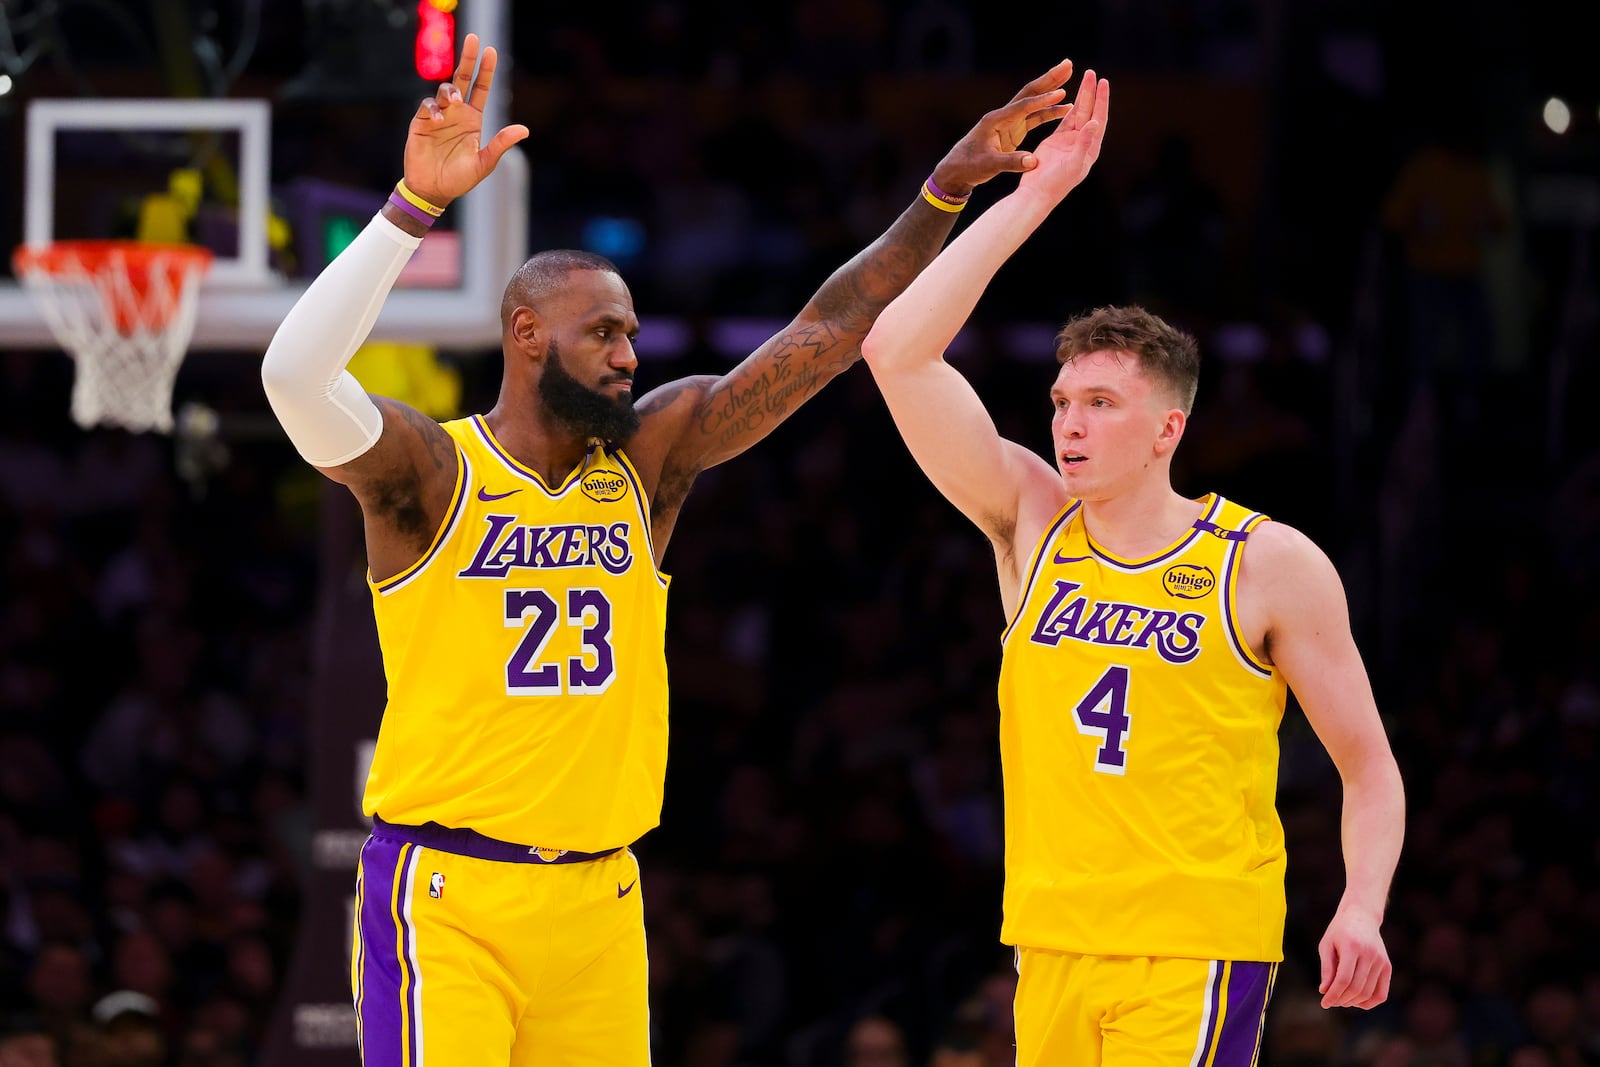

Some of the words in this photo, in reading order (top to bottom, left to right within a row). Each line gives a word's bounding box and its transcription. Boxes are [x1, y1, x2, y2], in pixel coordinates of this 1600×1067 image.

[584, 478, 624, 492] bibigo
[456, 513, 634, 579] LAKERS
[1168, 571, 1212, 590] bibigo
[504, 587, 617, 696] 23
[1029, 579, 1208, 666] LAKERS
[1071, 663, 1132, 776] 4
